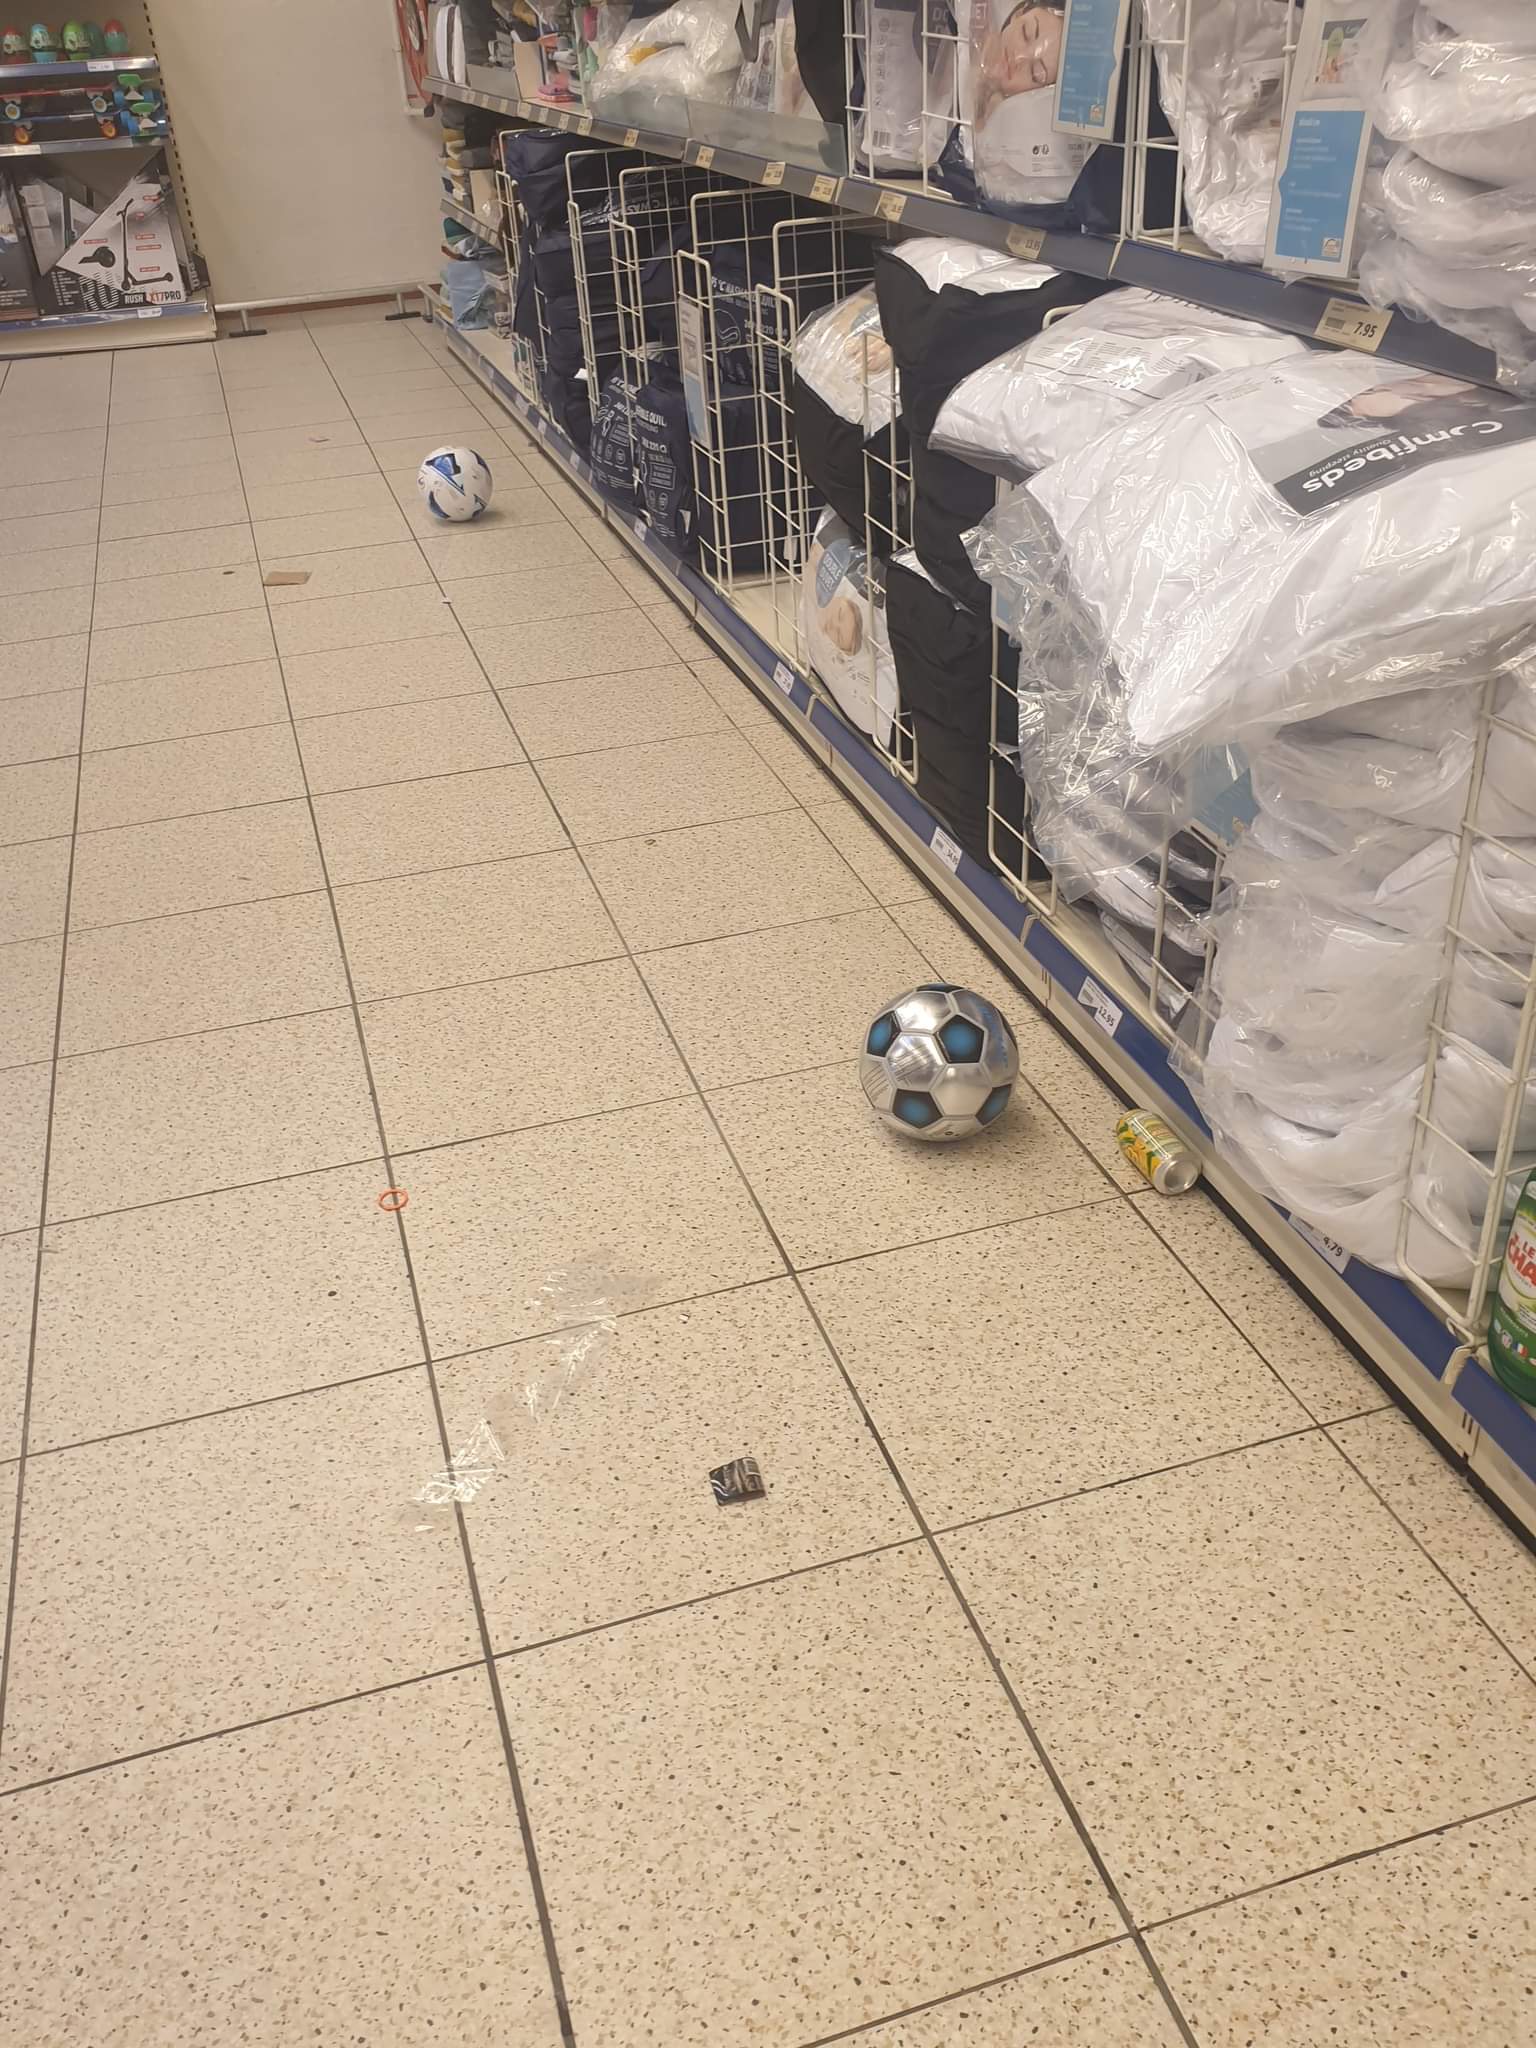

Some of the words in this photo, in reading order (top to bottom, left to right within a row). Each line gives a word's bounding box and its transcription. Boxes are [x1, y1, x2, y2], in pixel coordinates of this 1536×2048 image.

[125, 293, 144, 304] RUSH
[1353, 321, 1378, 338] 7.95
[1302, 420, 1504, 493] Comfibeds
[1309, 448, 1352, 477] sleeping
[1098, 1006, 1116, 1027] 12.95
[1508, 1232, 1536, 1288] CHA
[1523, 1240, 1536, 1260] LE
